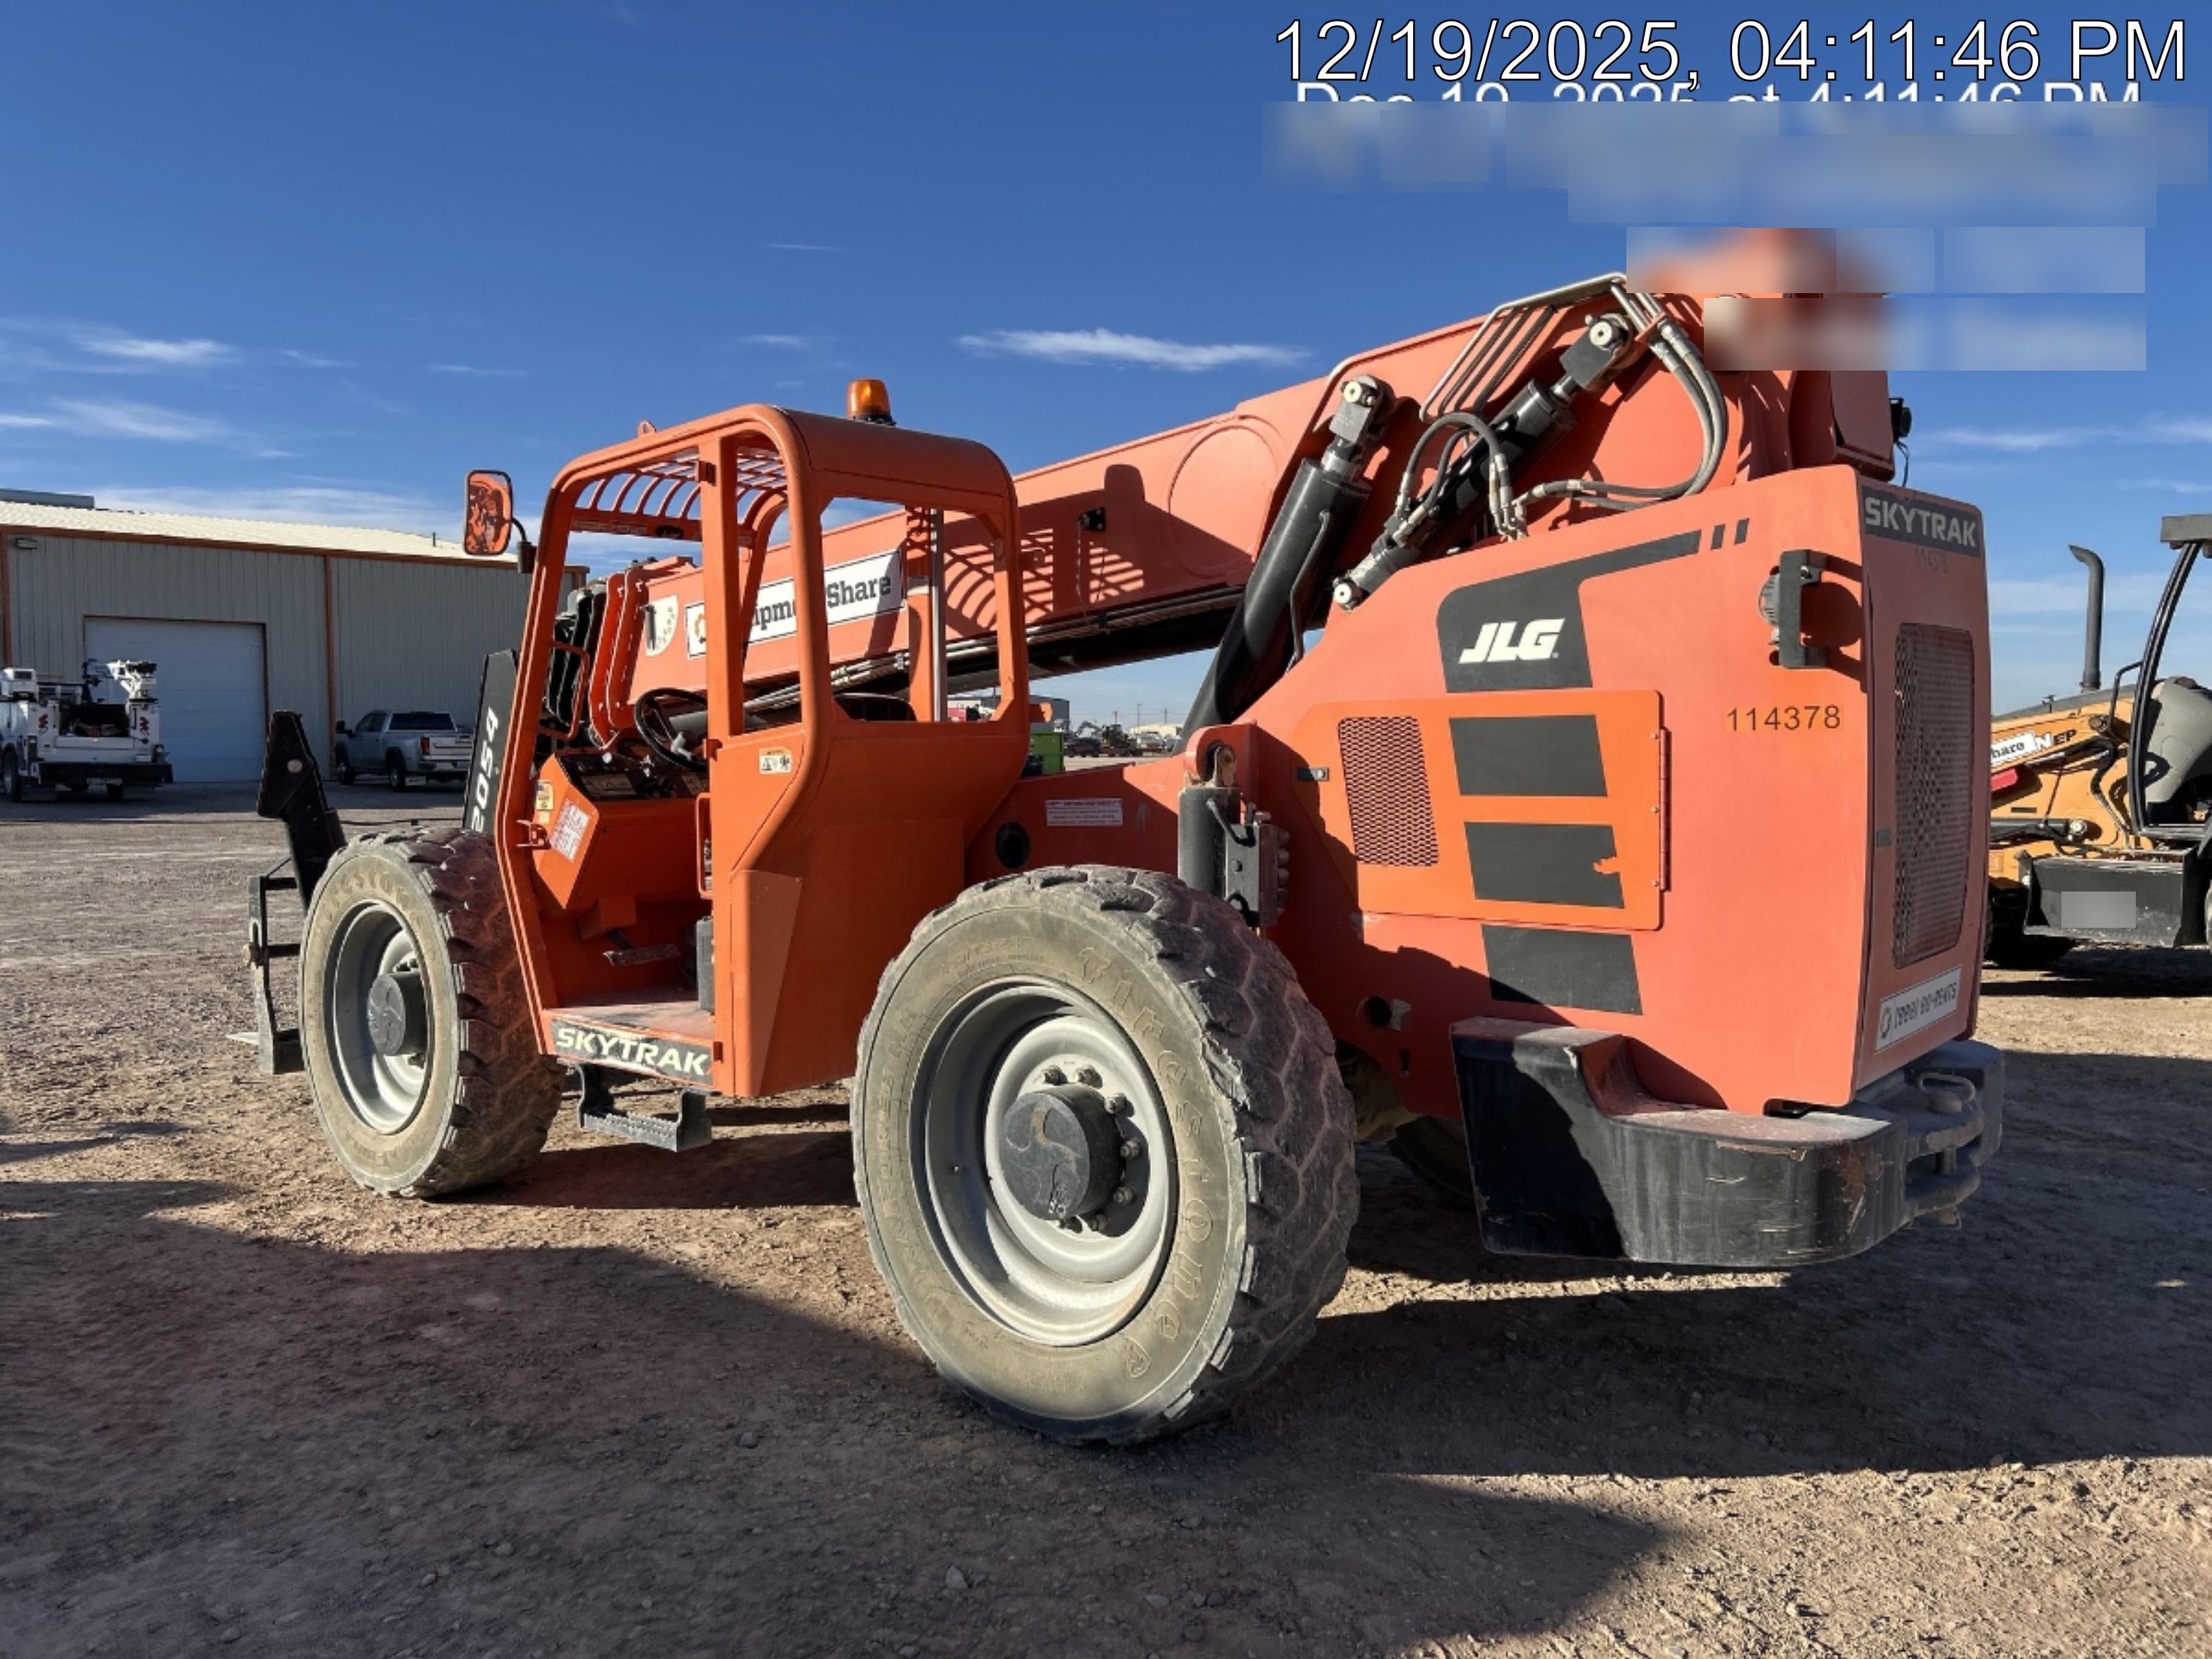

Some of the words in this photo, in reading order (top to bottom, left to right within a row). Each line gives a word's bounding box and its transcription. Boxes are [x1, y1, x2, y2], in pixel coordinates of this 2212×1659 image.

[1865, 497, 1977, 547] SKYTRAK
[1458, 617, 1566, 664] JLG
[1727, 705, 1840, 731] 114378
[556, 1027, 708, 1076] SKYTRAK
